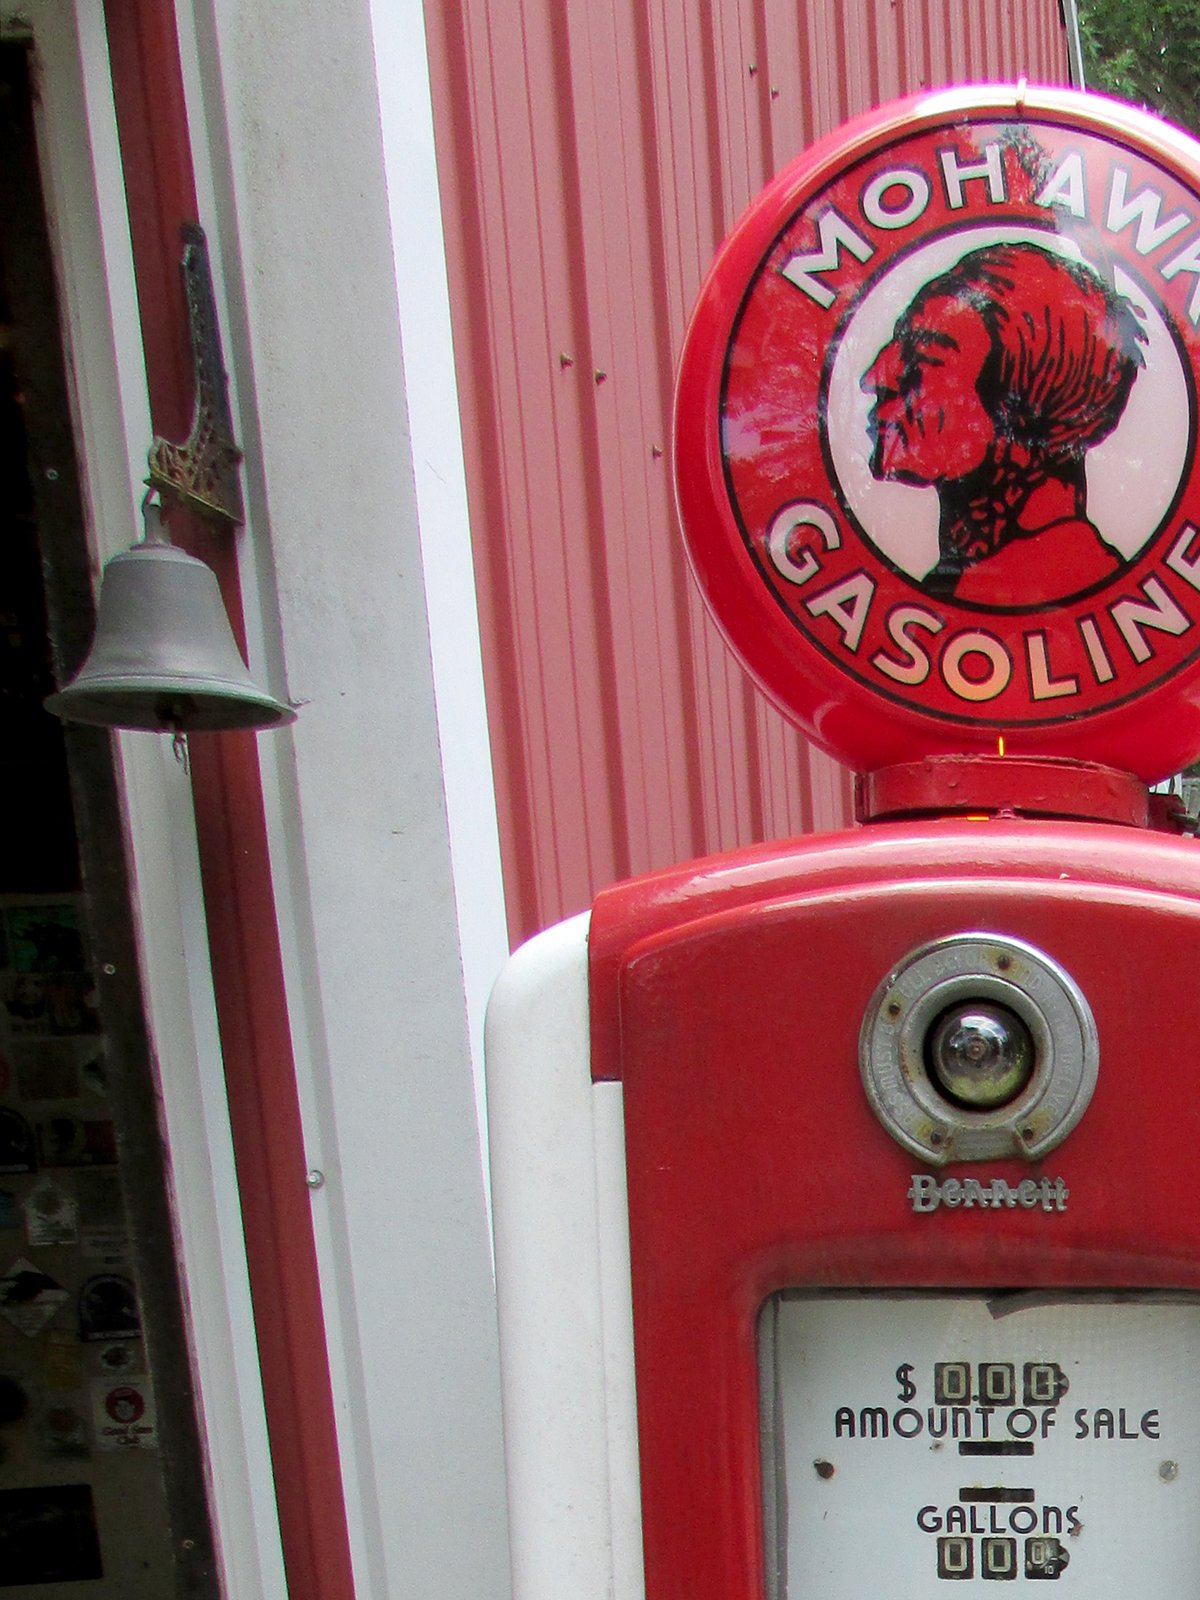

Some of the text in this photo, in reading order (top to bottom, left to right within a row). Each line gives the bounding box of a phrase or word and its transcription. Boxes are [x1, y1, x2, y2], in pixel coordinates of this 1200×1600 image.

[907, 1175, 1069, 1212] Bennett
[835, 1407, 1160, 1439] AMOUNT OF SALE
[917, 1505, 1080, 1533] GALLONS
